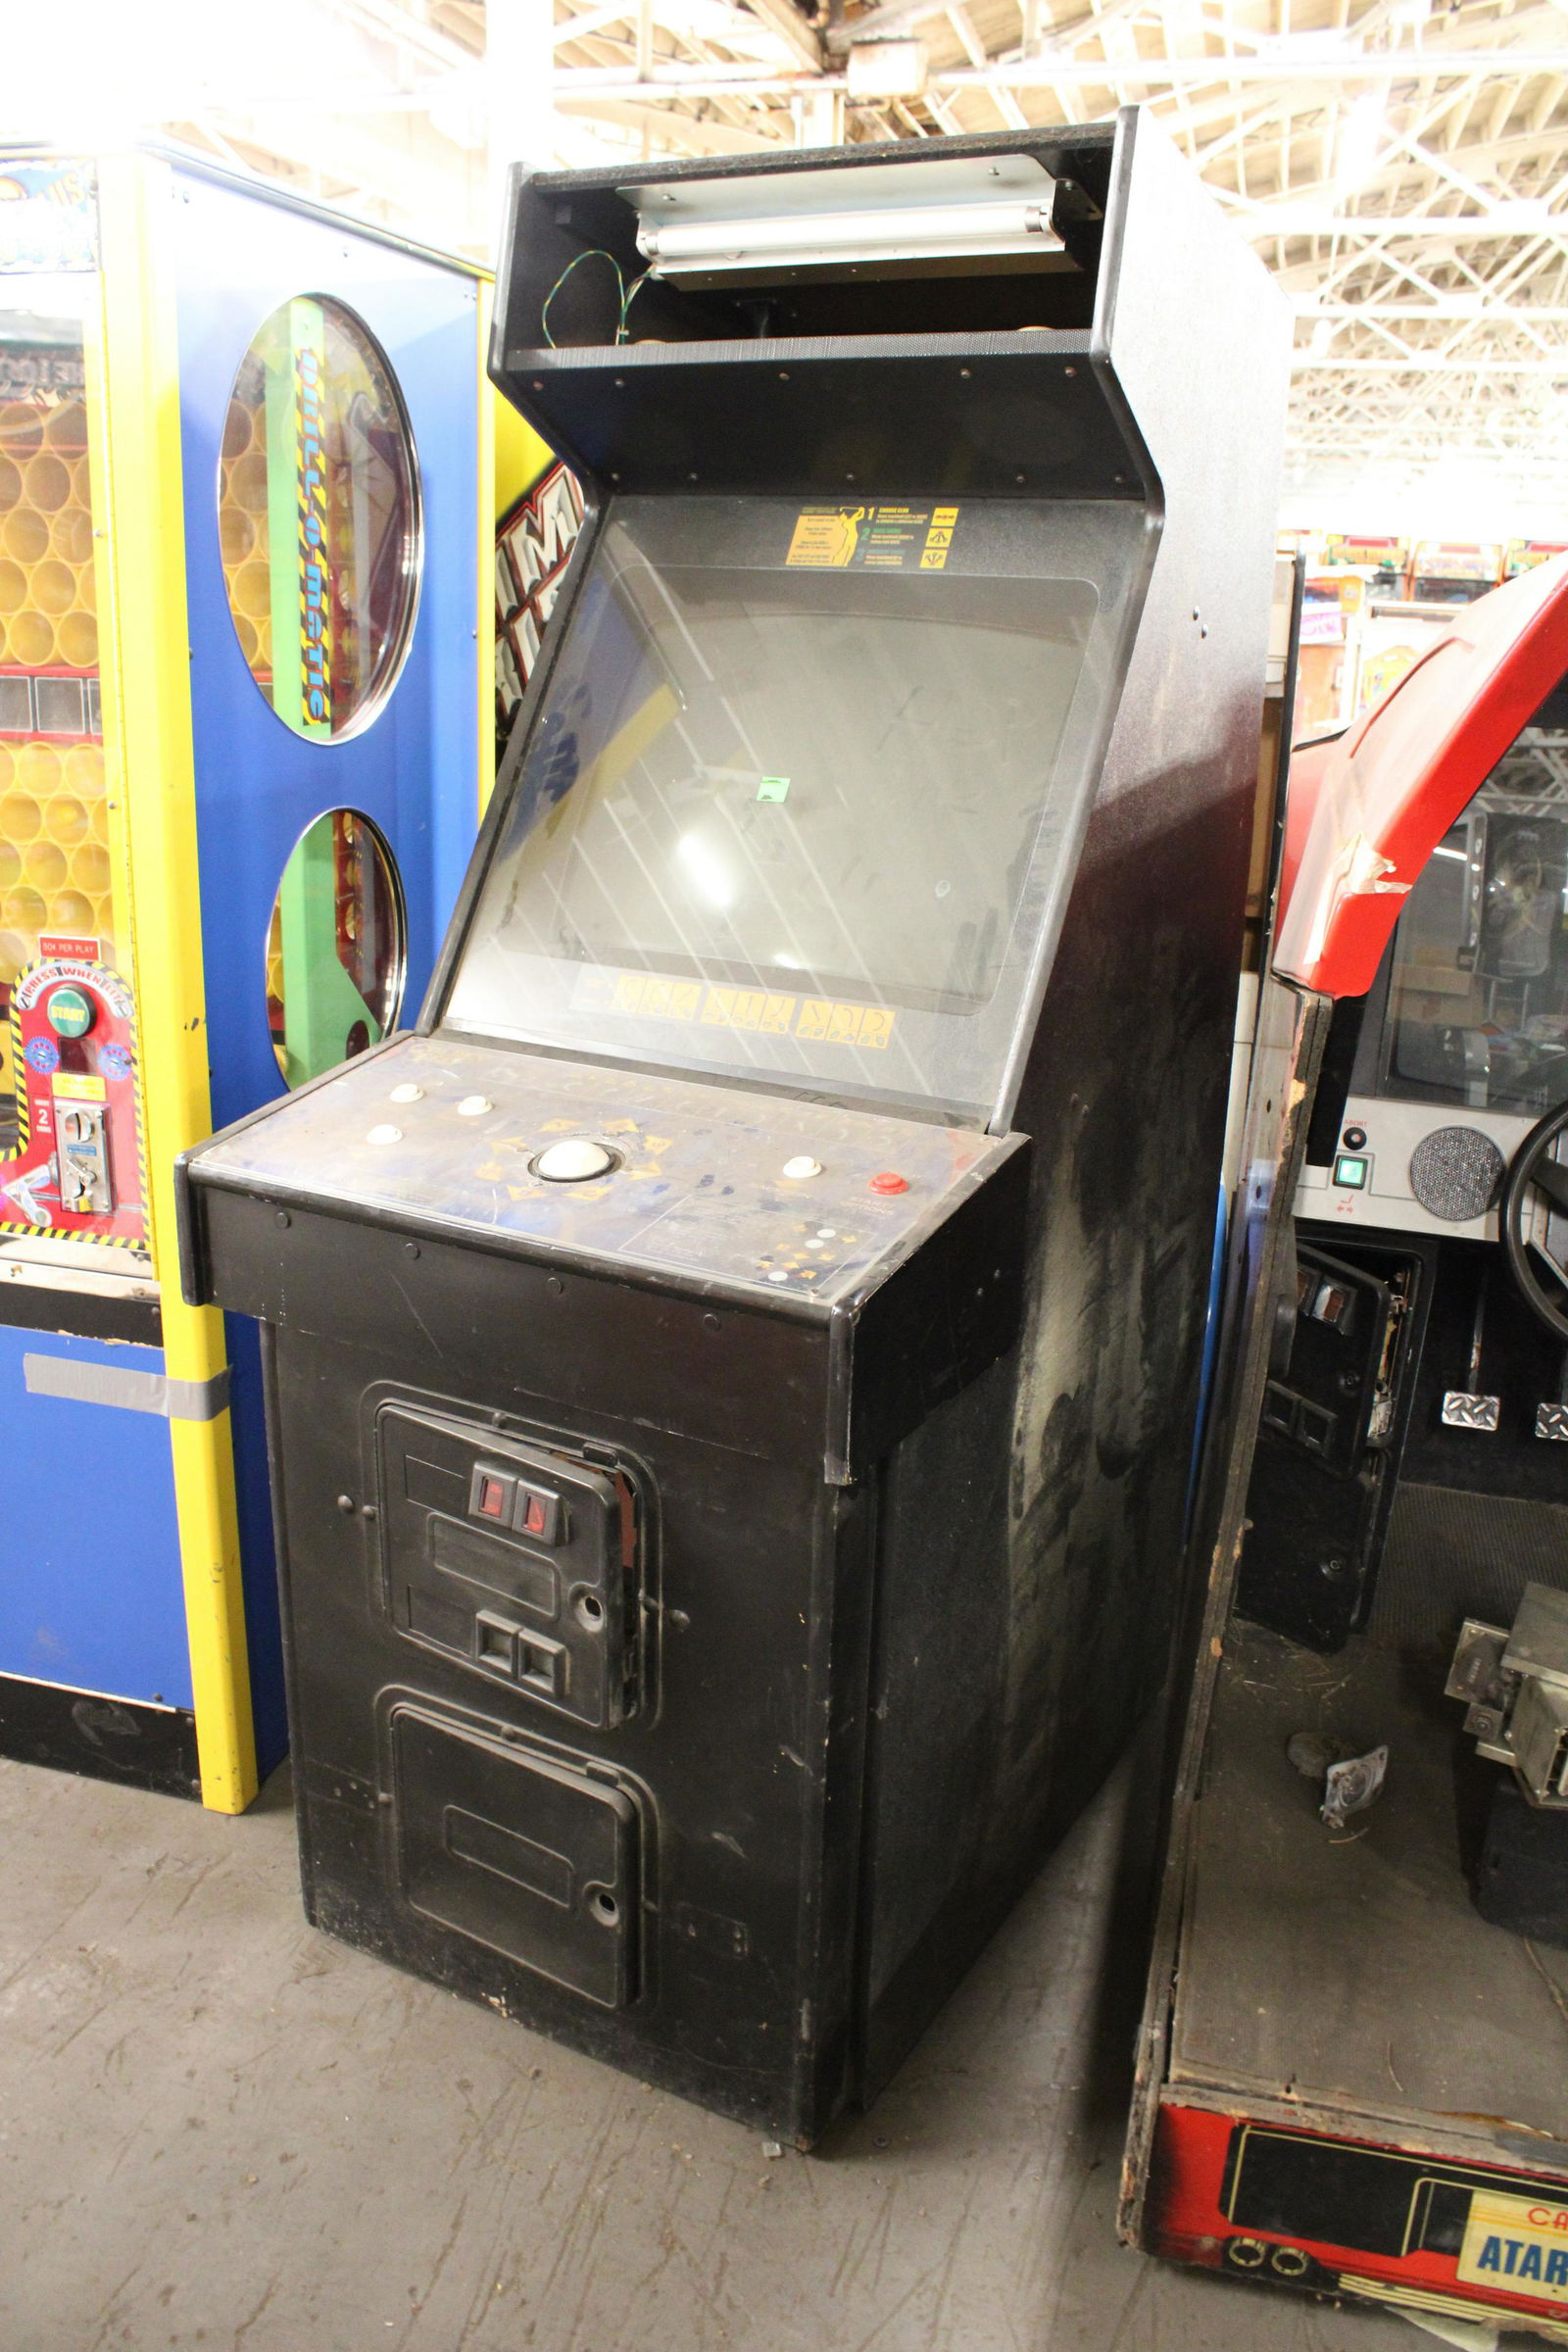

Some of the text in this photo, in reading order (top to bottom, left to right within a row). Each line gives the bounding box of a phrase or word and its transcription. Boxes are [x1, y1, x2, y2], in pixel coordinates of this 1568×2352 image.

[59, 943, 73, 953] PER
[75, 944, 94, 954] PLAY
[26, 966, 58, 992] PRESS
[62, 966, 102, 985] WHEN
[50, 1005, 85, 1022] START
[38, 1108, 48, 1125] 2
